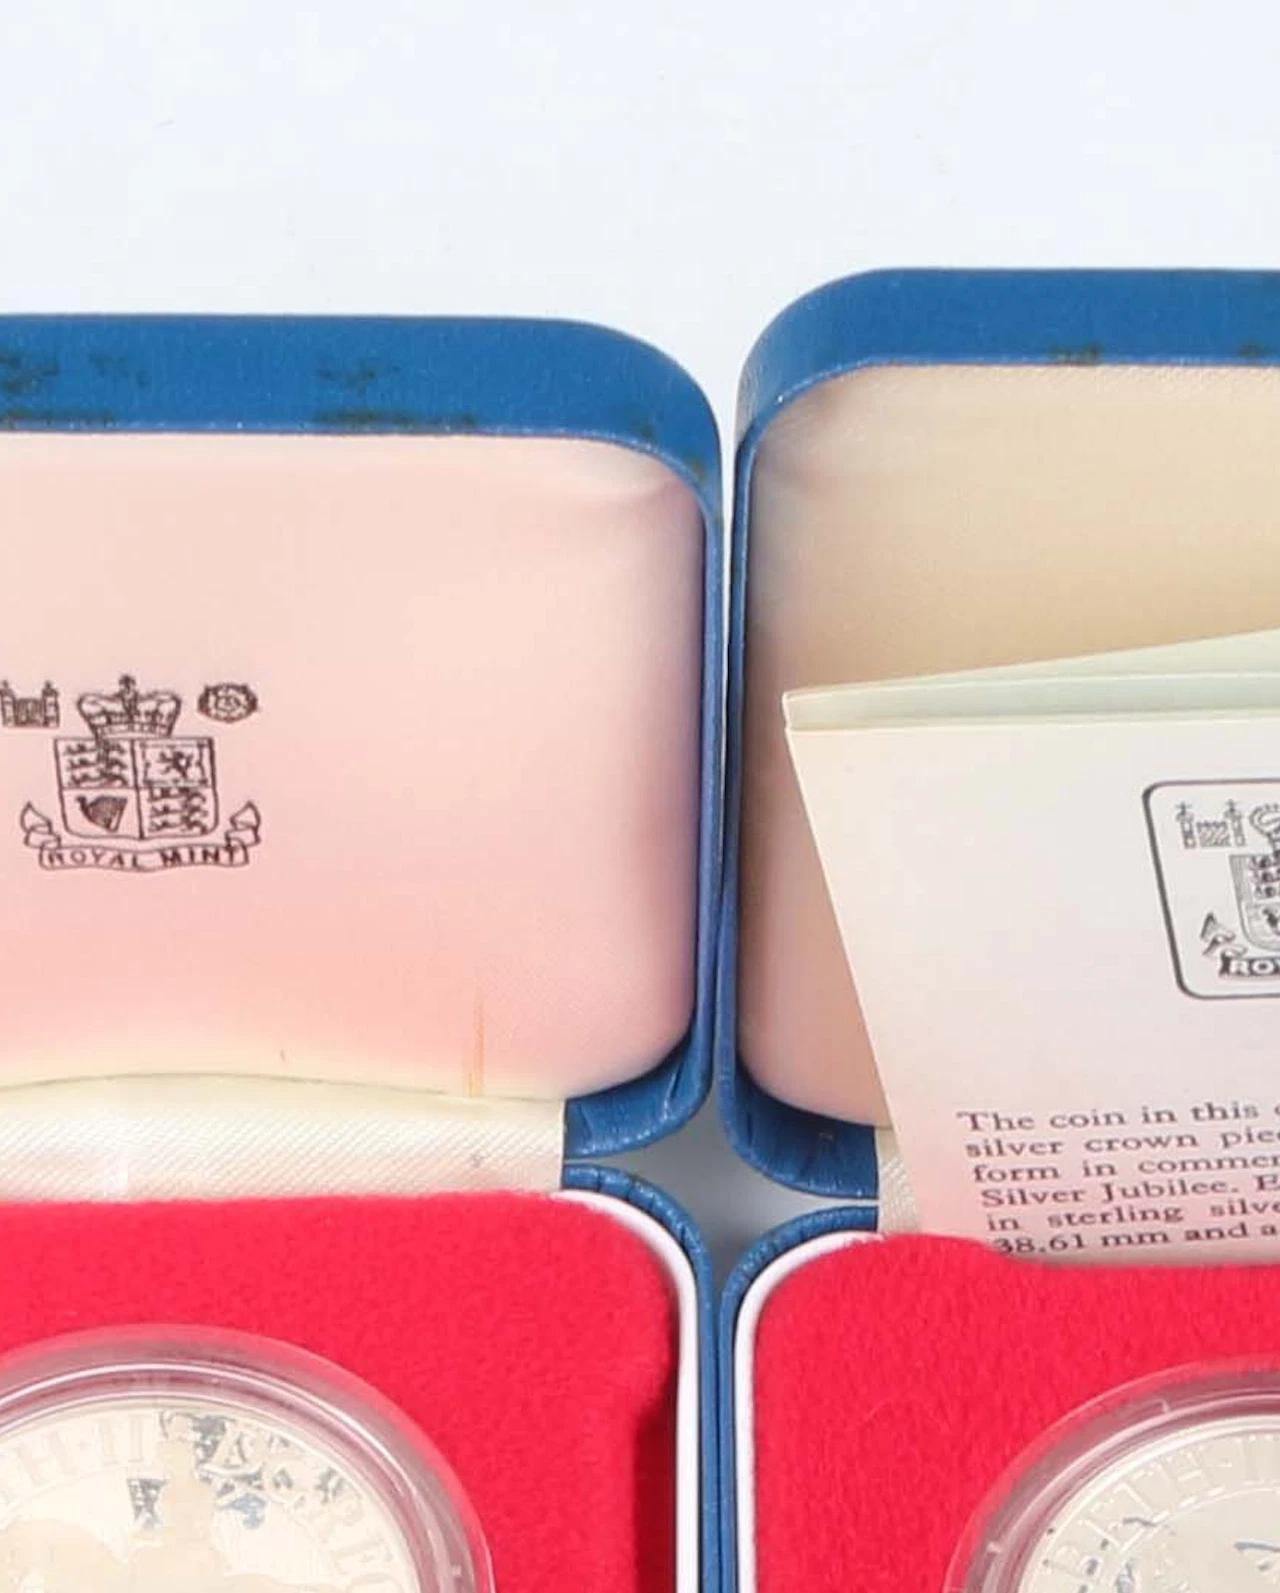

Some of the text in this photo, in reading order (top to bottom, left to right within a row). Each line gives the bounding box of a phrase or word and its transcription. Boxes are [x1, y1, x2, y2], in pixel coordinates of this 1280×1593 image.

[47, 846, 238, 868] ROYAL MINT
[957, 1111, 1035, 1132] The
[1049, 1109, 1124, 1129] coin
[1141, 1106, 1177, 1124] in
[1192, 1101, 1259, 1122] this
[964, 1137, 1064, 1158] silver
[1084, 1133, 1197, 1153] crown
[972, 1164, 1061, 1184] form
[1082, 1160, 1117, 1178] in
[981, 1187, 1086, 1208] Silver
[1102, 1177, 1239, 1204] Jubilee.
[987, 1214, 1019, 1232] in
[1047, 1203, 1184, 1228] sterling
[991, 1232, 1086, 1256] 38.61
[1101, 1229, 1169, 1247] mm
[1183, 1223, 1249, 1242] and
[1260, 1220, 1277, 1236] a
